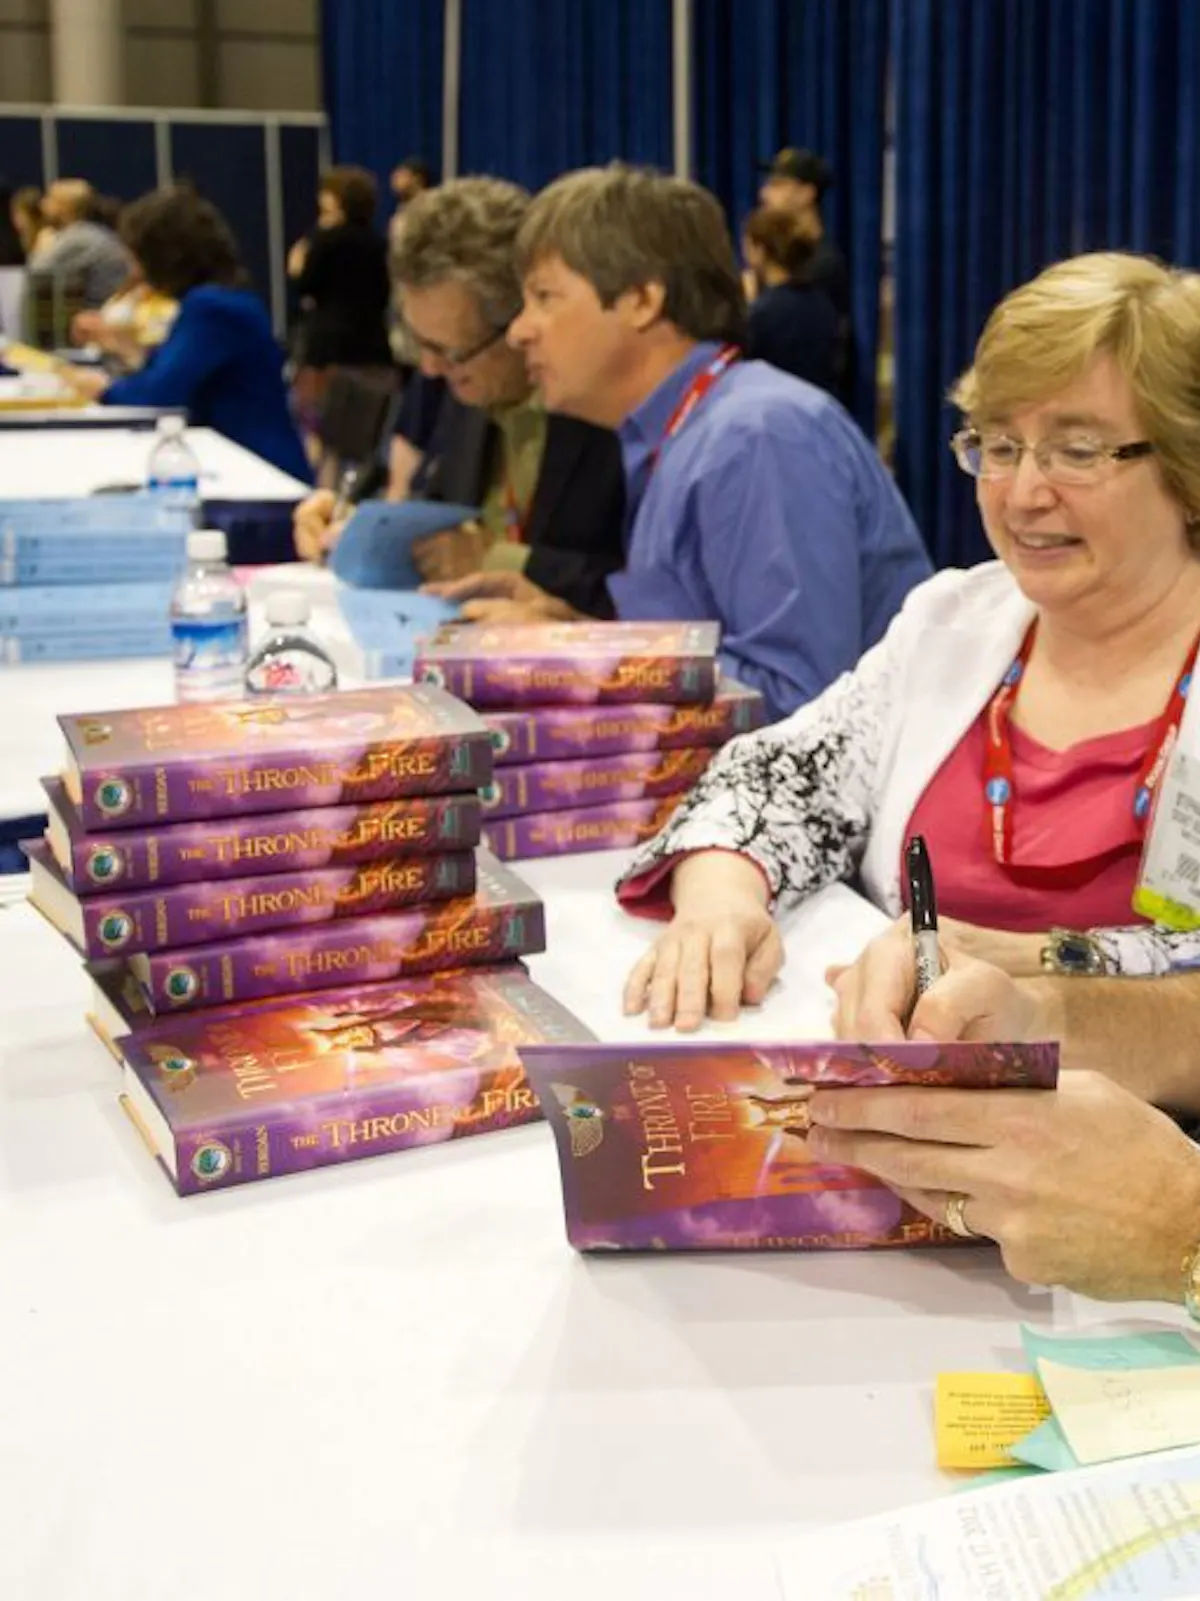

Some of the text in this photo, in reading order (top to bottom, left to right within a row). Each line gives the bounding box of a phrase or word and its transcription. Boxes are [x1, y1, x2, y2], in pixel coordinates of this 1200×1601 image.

[217, 764, 338, 795] THRONE
[368, 752, 437, 780] FIRE
[208, 829, 328, 863] THRONE
[357, 817, 426, 847] FIRE
[218, 888, 329, 922] THRONE
[358, 864, 426, 896] FIRE
[285, 940, 400, 977] THRONE
[424, 926, 491, 954] FIRE
[291, 1133, 319, 1151] THE
[321, 1109, 455, 1149] THRONE
[629, 1079, 686, 1191] THRONE
[685, 1084, 737, 1143] FIRE
